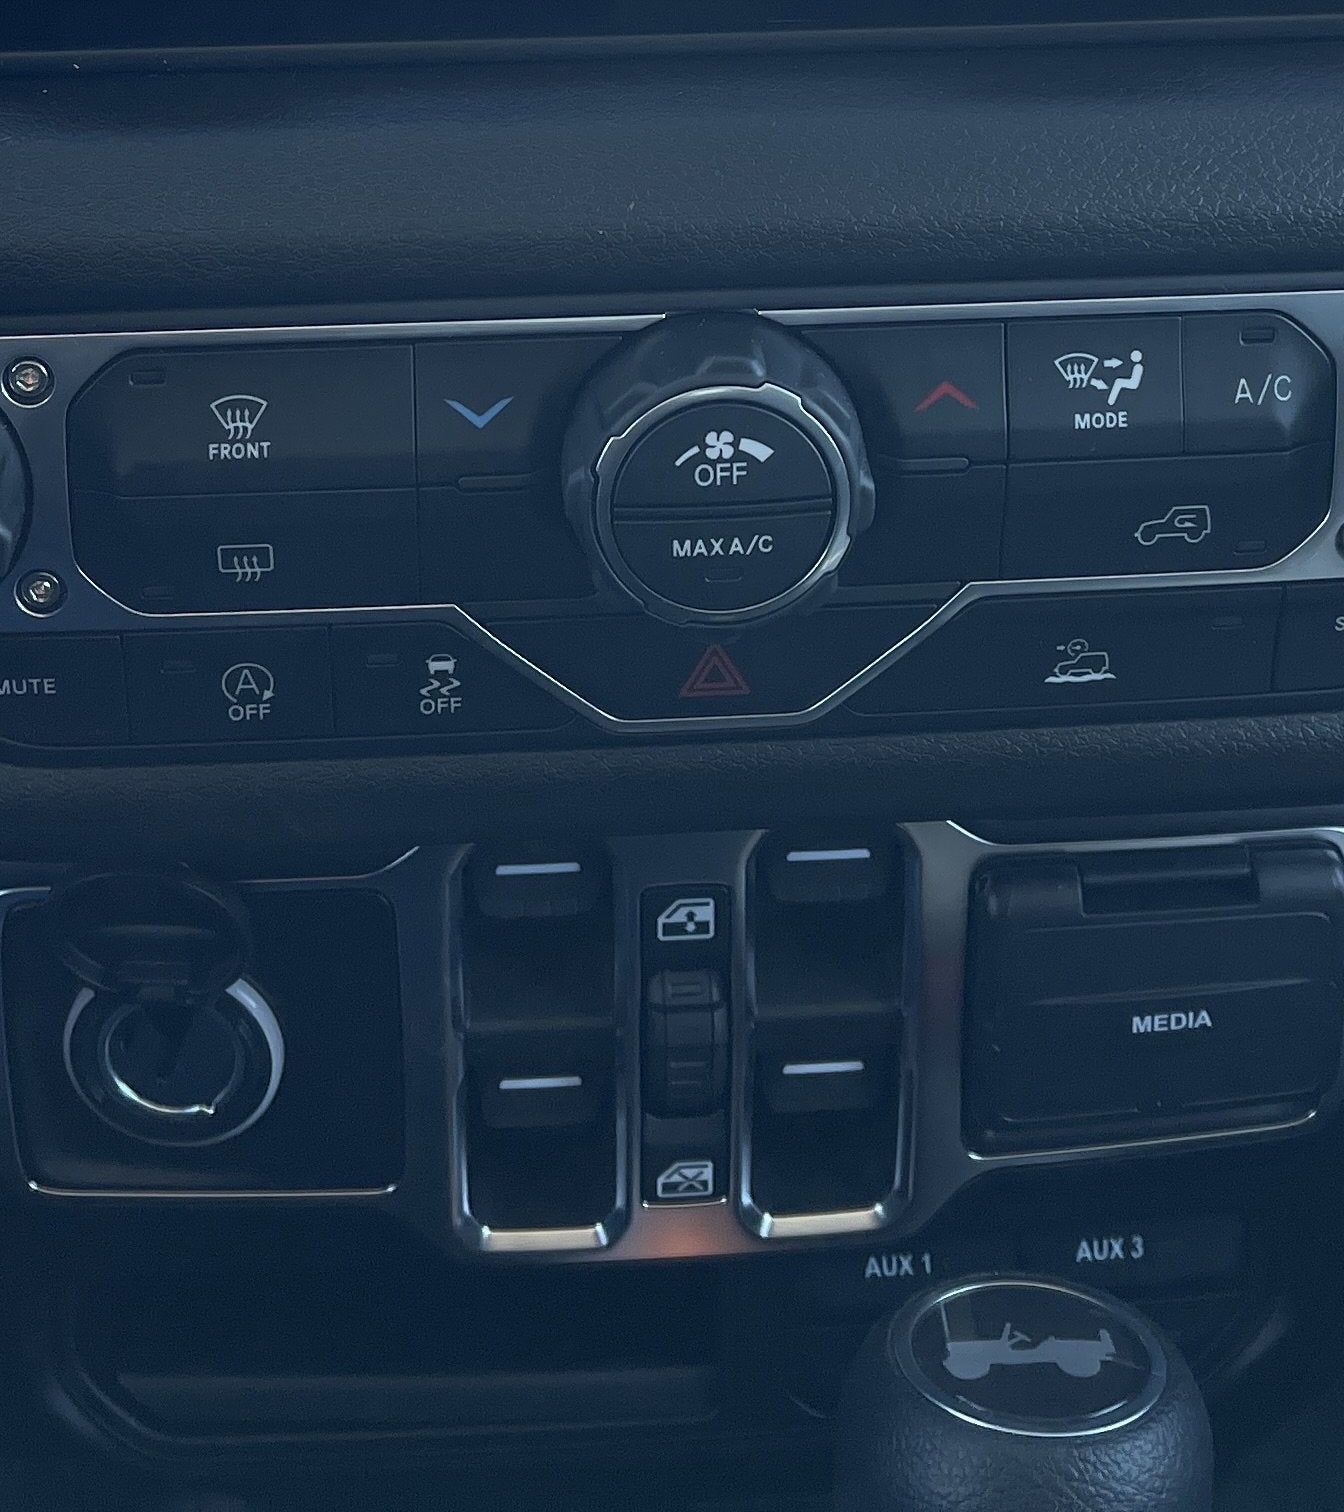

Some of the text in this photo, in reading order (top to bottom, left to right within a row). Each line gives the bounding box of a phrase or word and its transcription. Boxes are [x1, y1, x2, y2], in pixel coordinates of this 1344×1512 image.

[1233, 374, 1293, 406] A/C
[1073, 410, 1129, 431] MODE
[208, 440, 271, 461] FRONT
[693, 462, 748, 488] OFF
[671, 533, 775, 558] MAX A/C
[227, 703, 272, 722] OFF
[419, 697, 463, 716] OFF
[1131, 1009, 1213, 1035] MEDIA
[1075, 1234, 1146, 1264] AUX 3
[864, 1252, 934, 1280] AUX 1
